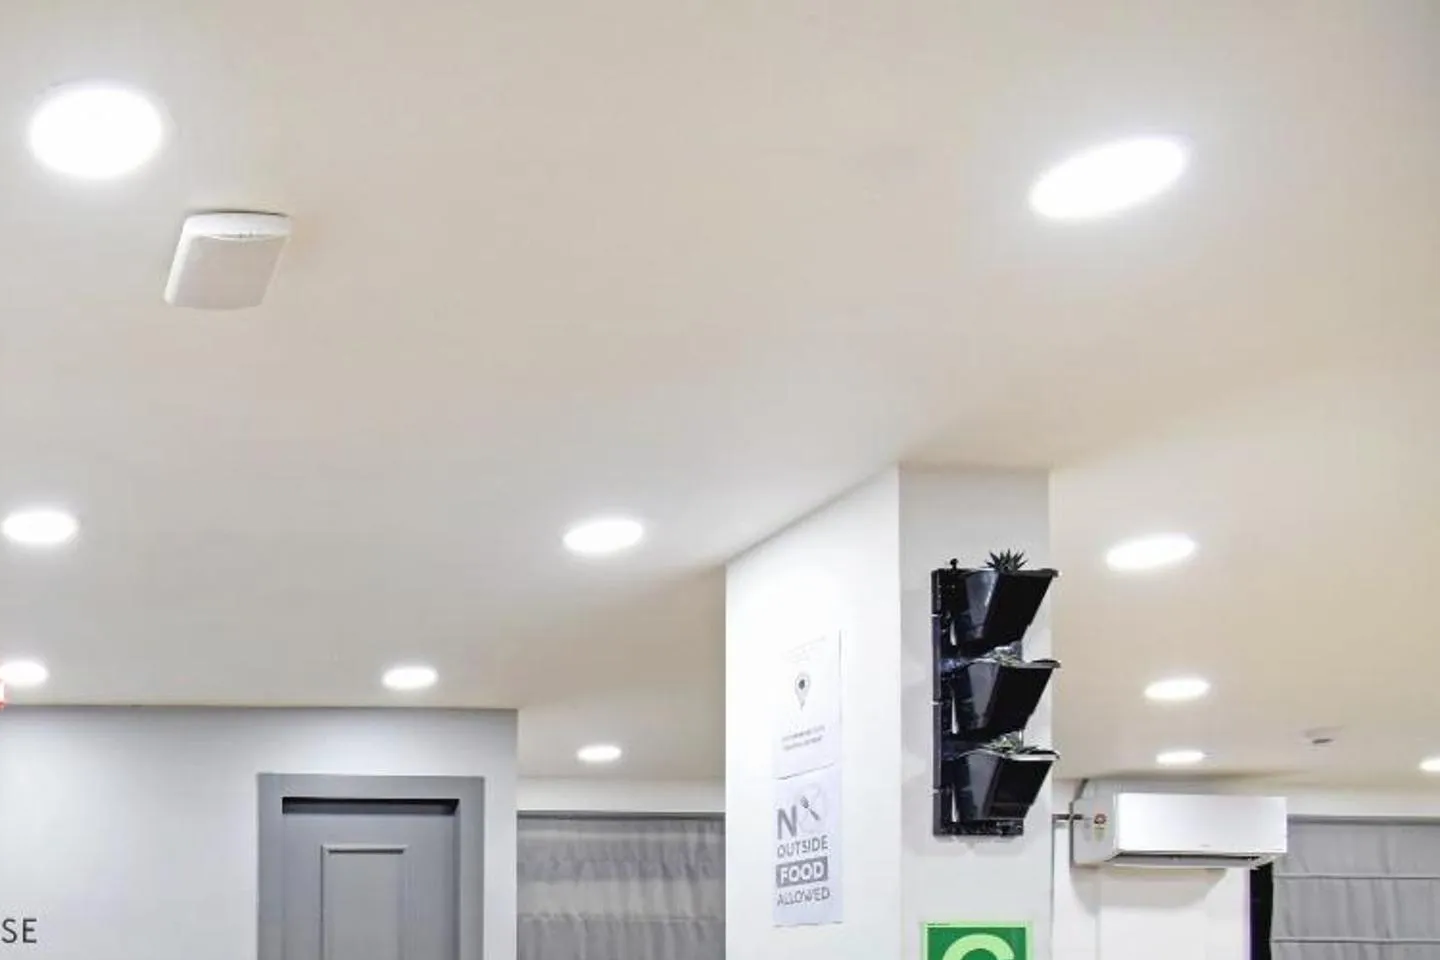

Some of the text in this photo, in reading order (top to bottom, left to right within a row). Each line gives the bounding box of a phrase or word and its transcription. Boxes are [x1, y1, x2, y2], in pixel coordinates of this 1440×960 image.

[777, 834, 829, 859] OUTSIDE
[780, 861, 825, 885] FOOD
[777, 886, 831, 907] ALLOWED
